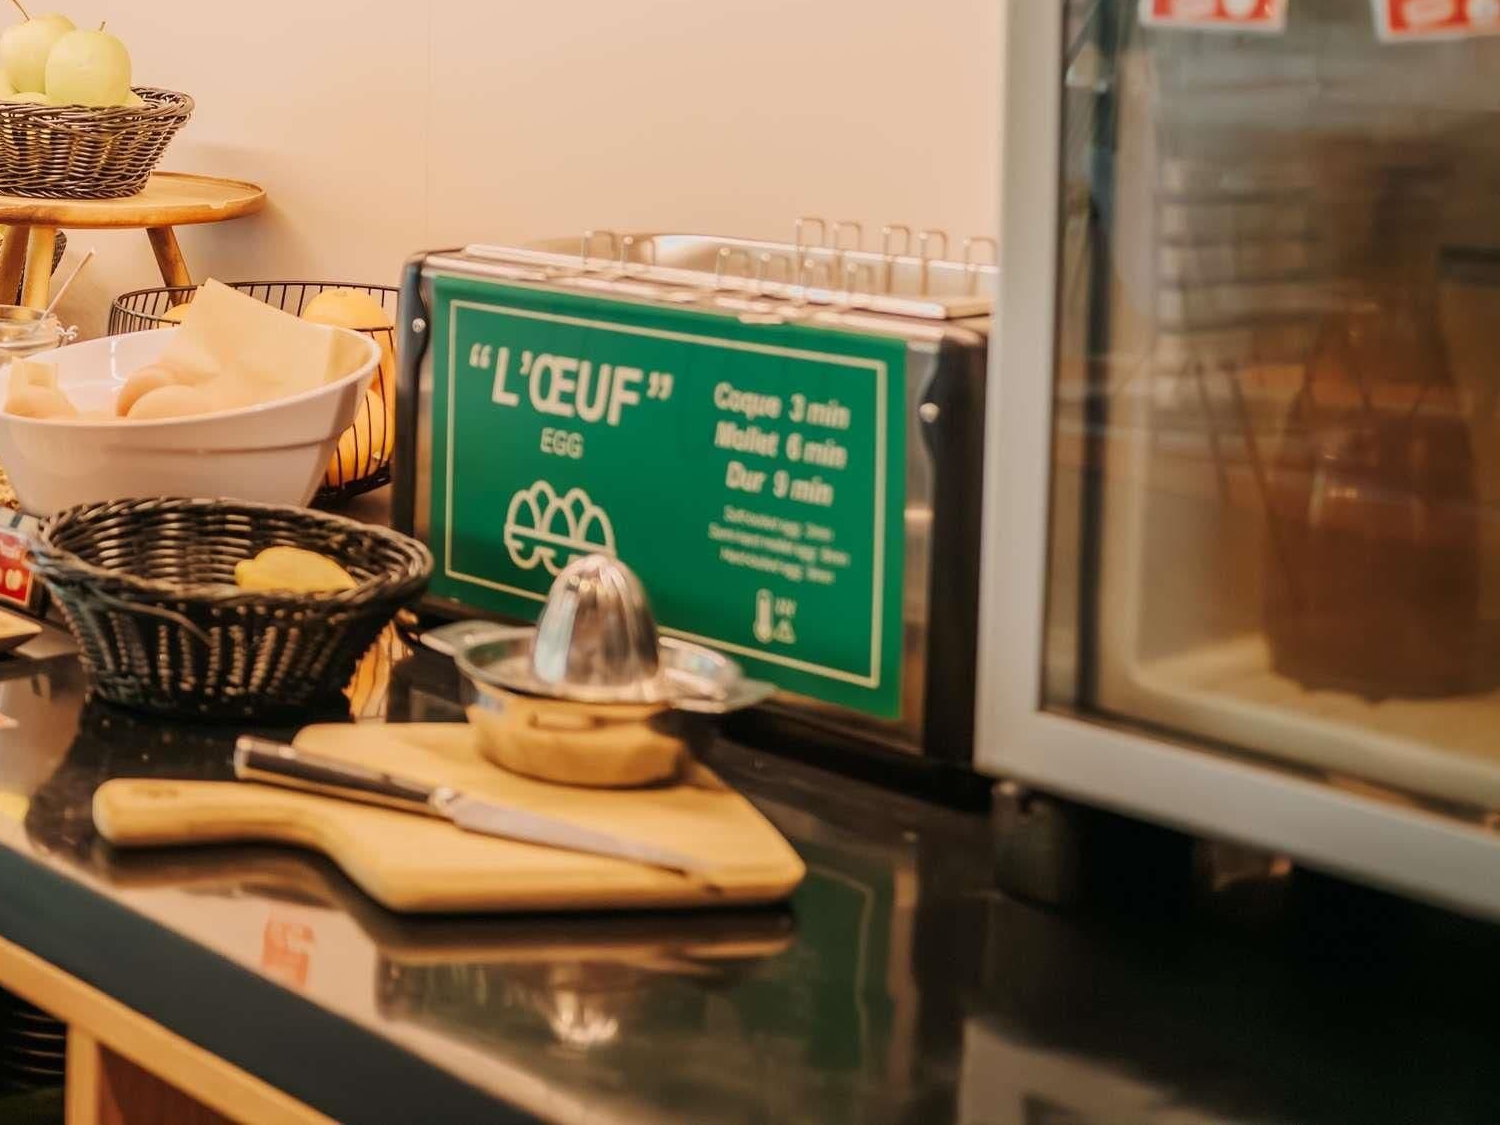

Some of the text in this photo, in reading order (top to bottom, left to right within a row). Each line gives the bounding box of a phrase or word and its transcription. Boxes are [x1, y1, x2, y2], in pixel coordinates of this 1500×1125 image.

[714, 381, 782, 420] Coque
[540, 427, 585, 460] EGG
[714, 420, 780, 459] Mollet
[725, 460, 767, 494] Dur
